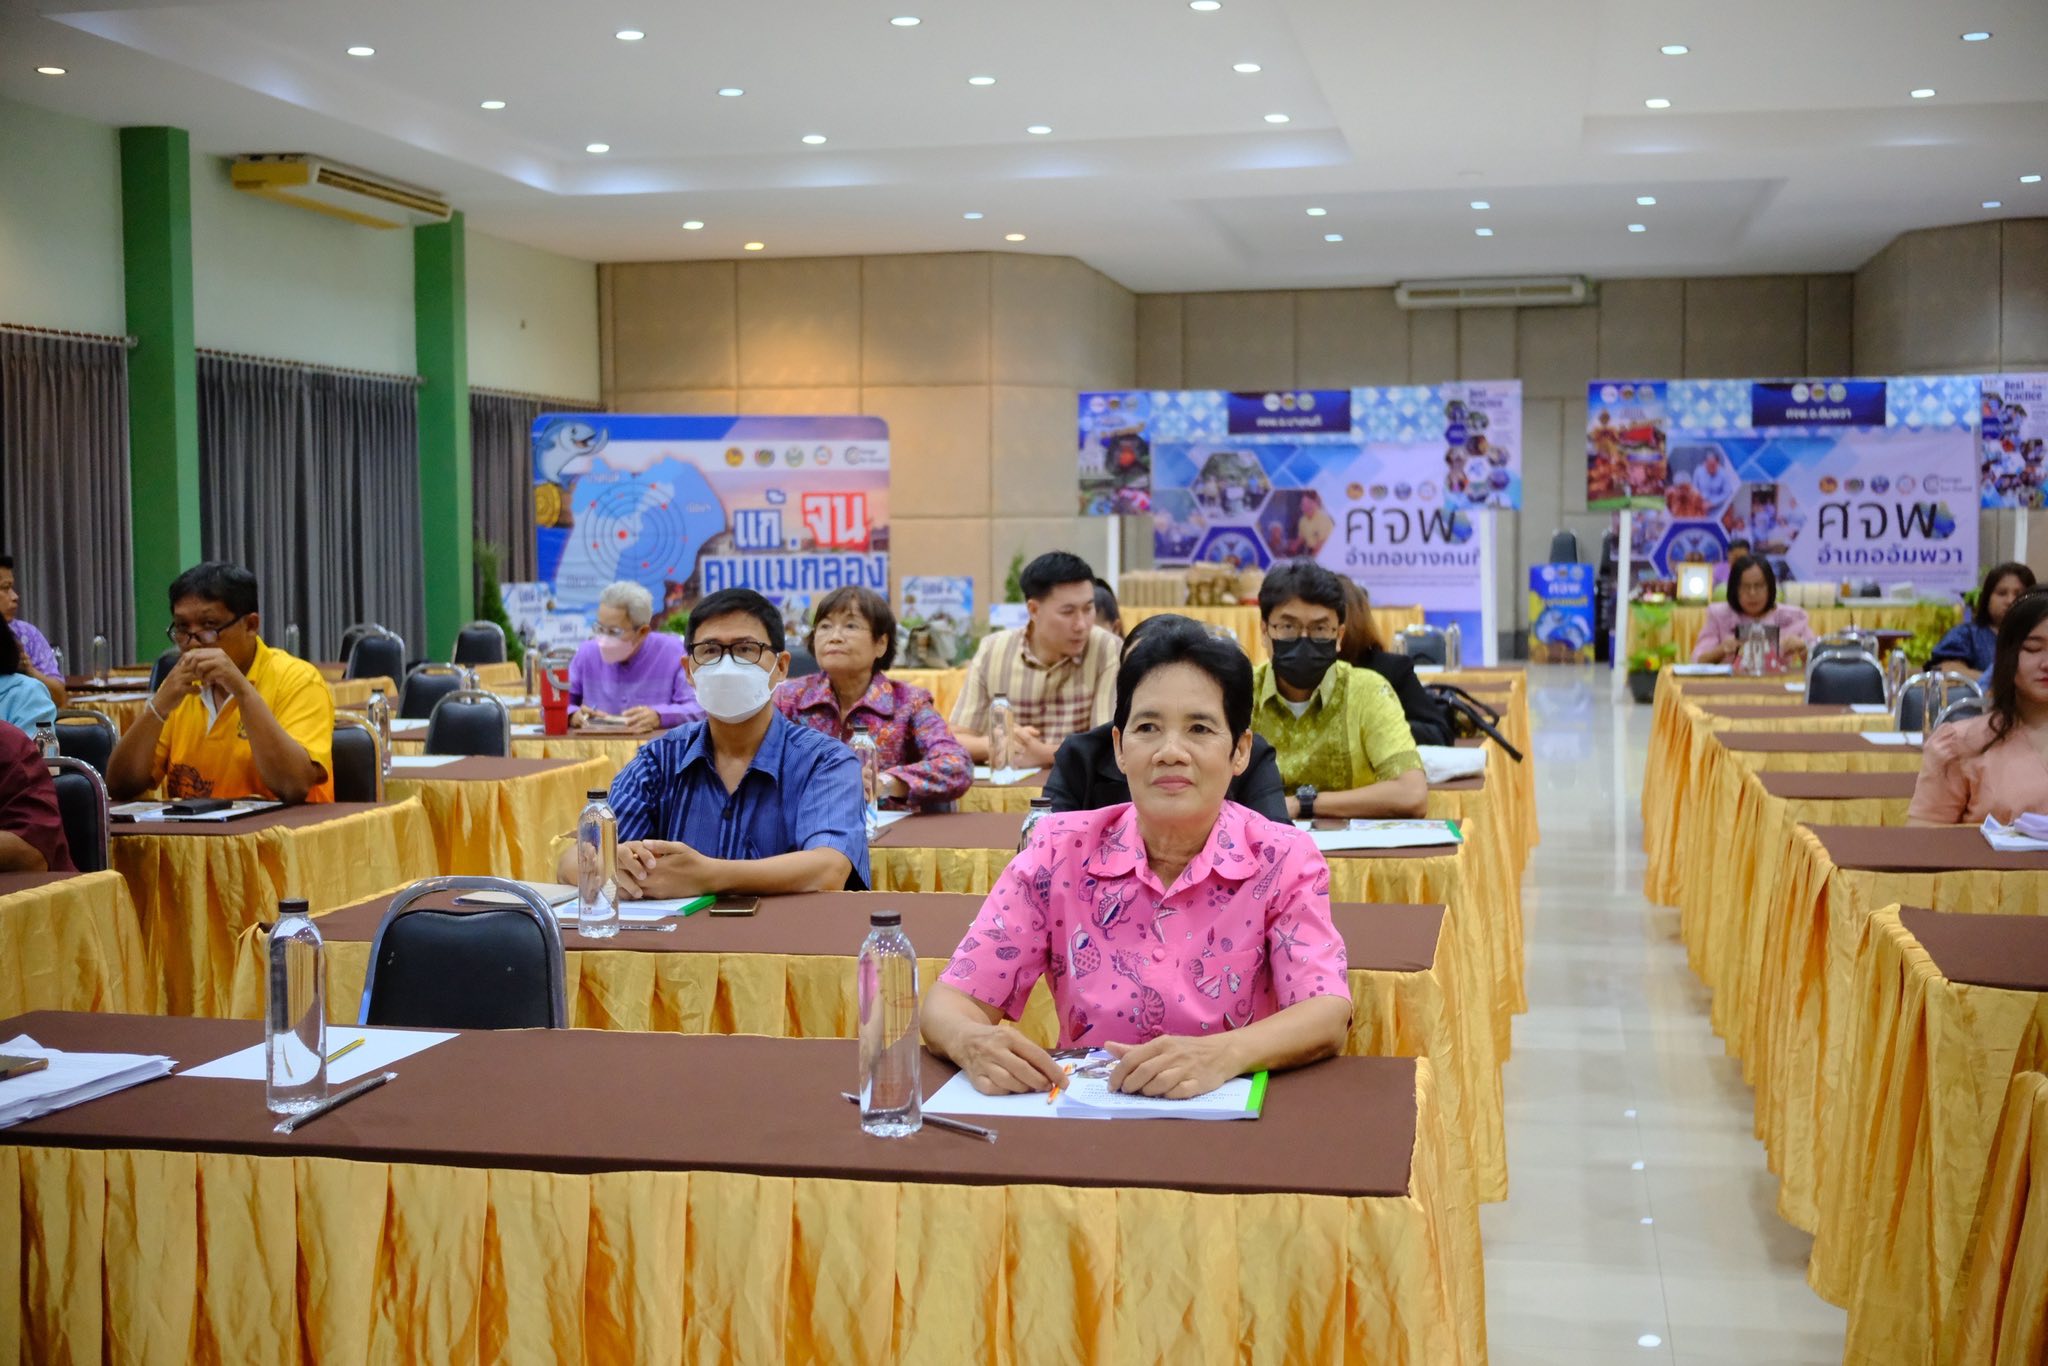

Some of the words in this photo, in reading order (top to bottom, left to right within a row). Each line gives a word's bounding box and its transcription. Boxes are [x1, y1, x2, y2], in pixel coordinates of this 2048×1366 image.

[734, 489, 786, 550] แก้
[803, 493, 870, 550] จน
[1346, 506, 1456, 544] ศจพ
[1818, 501, 1937, 540] ศจพ
[1818, 542, 1963, 565] อำเภออัมพวา
